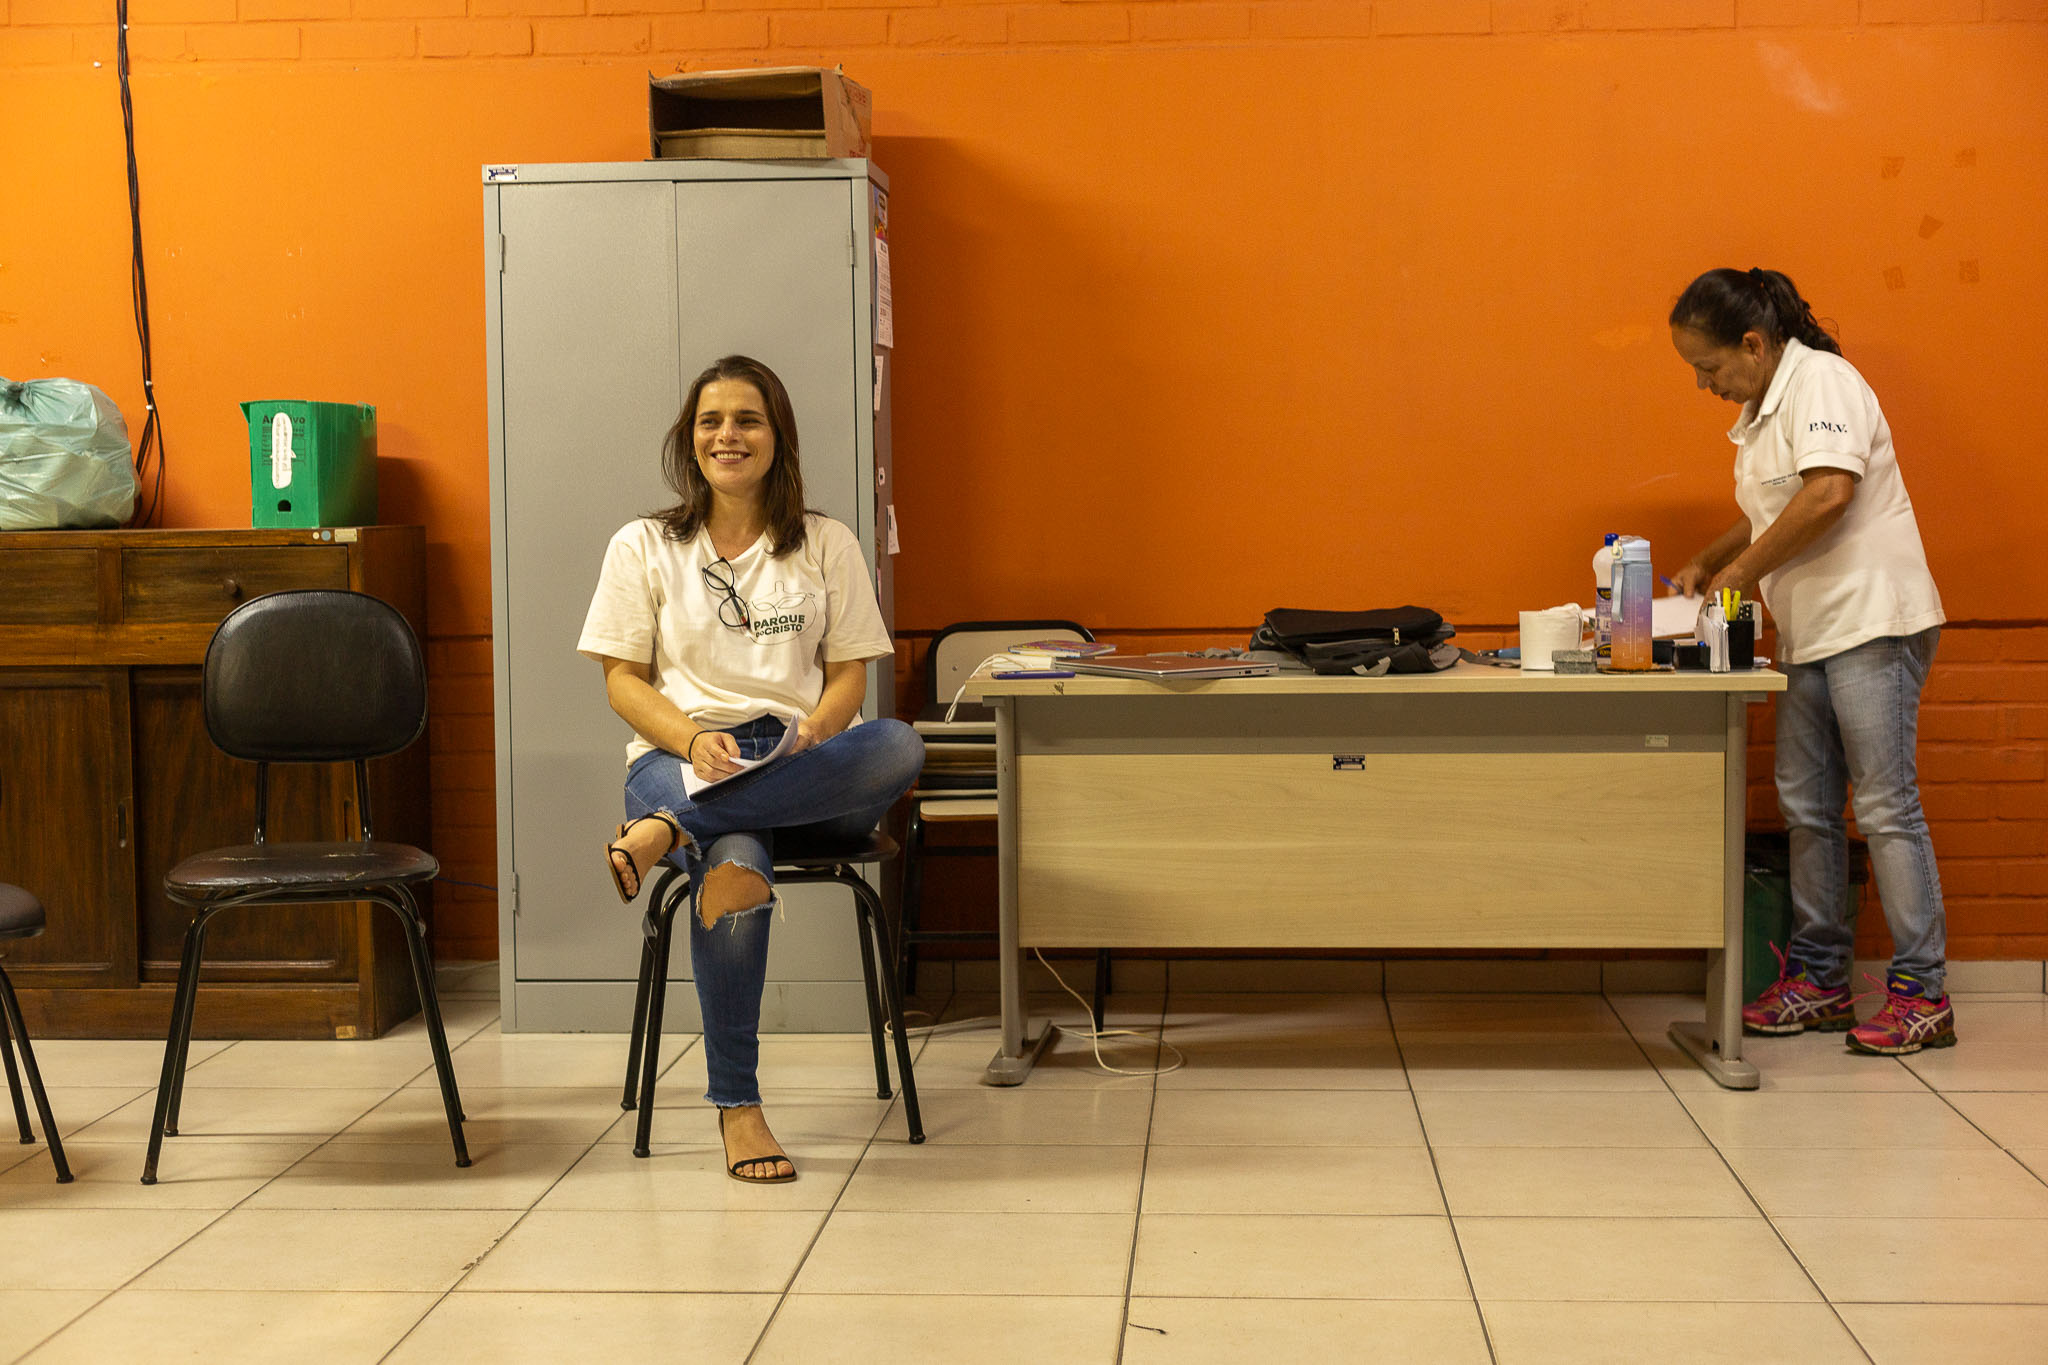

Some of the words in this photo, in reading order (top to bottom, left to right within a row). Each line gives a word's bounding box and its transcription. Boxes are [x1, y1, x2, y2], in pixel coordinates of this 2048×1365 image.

[1810, 421, 1848, 433] P.M.V.
[754, 614, 805, 631] PARQUE
[765, 624, 802, 635] CRISTO
